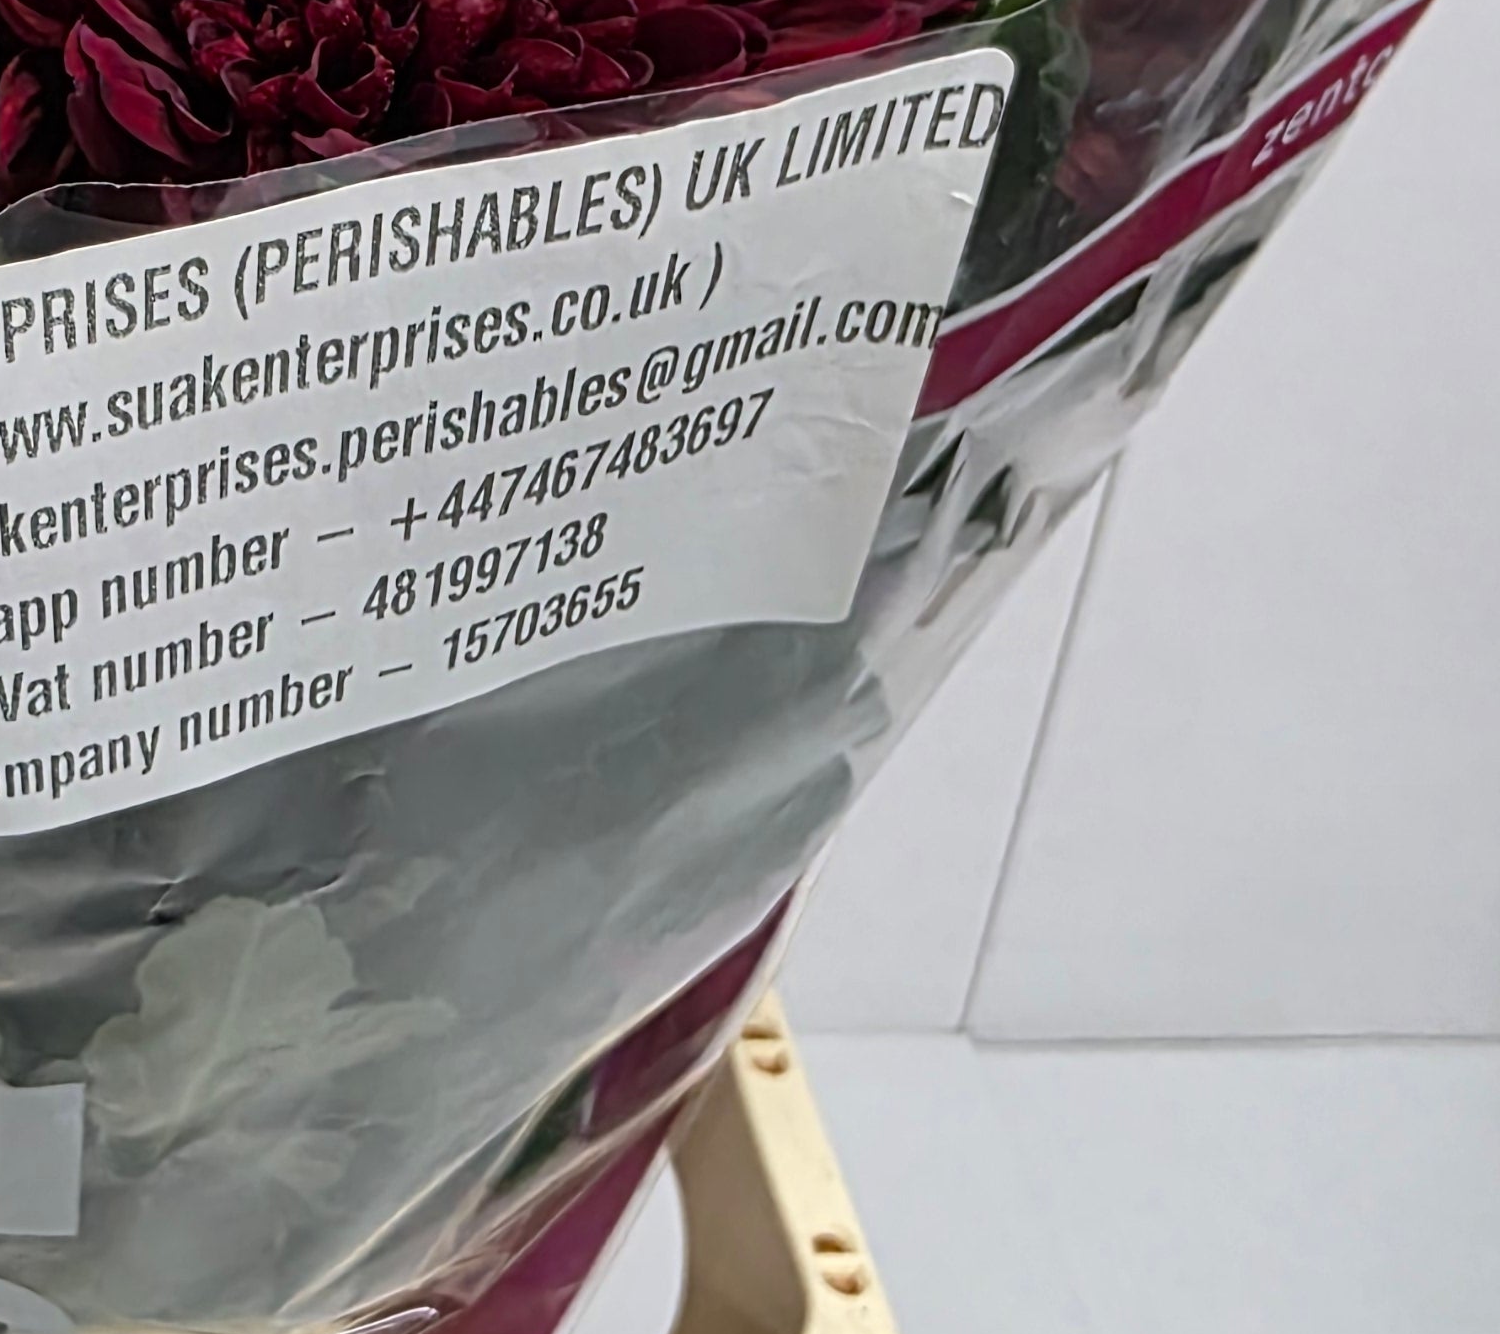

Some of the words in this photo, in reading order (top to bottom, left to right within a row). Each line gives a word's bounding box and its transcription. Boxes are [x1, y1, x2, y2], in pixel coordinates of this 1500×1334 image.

[235, 162, 664, 321] (PERISHABLES)
[686, 137, 766, 212] UK
[776, 81, 1004, 189] LIMITED
[92, 611, 274, 703] number
[362, 511, 609, 621] 481997138
[101, 527, 290, 620] number
[179, 664, 354, 752] number
[444, 565, 645, 671] 15703655
